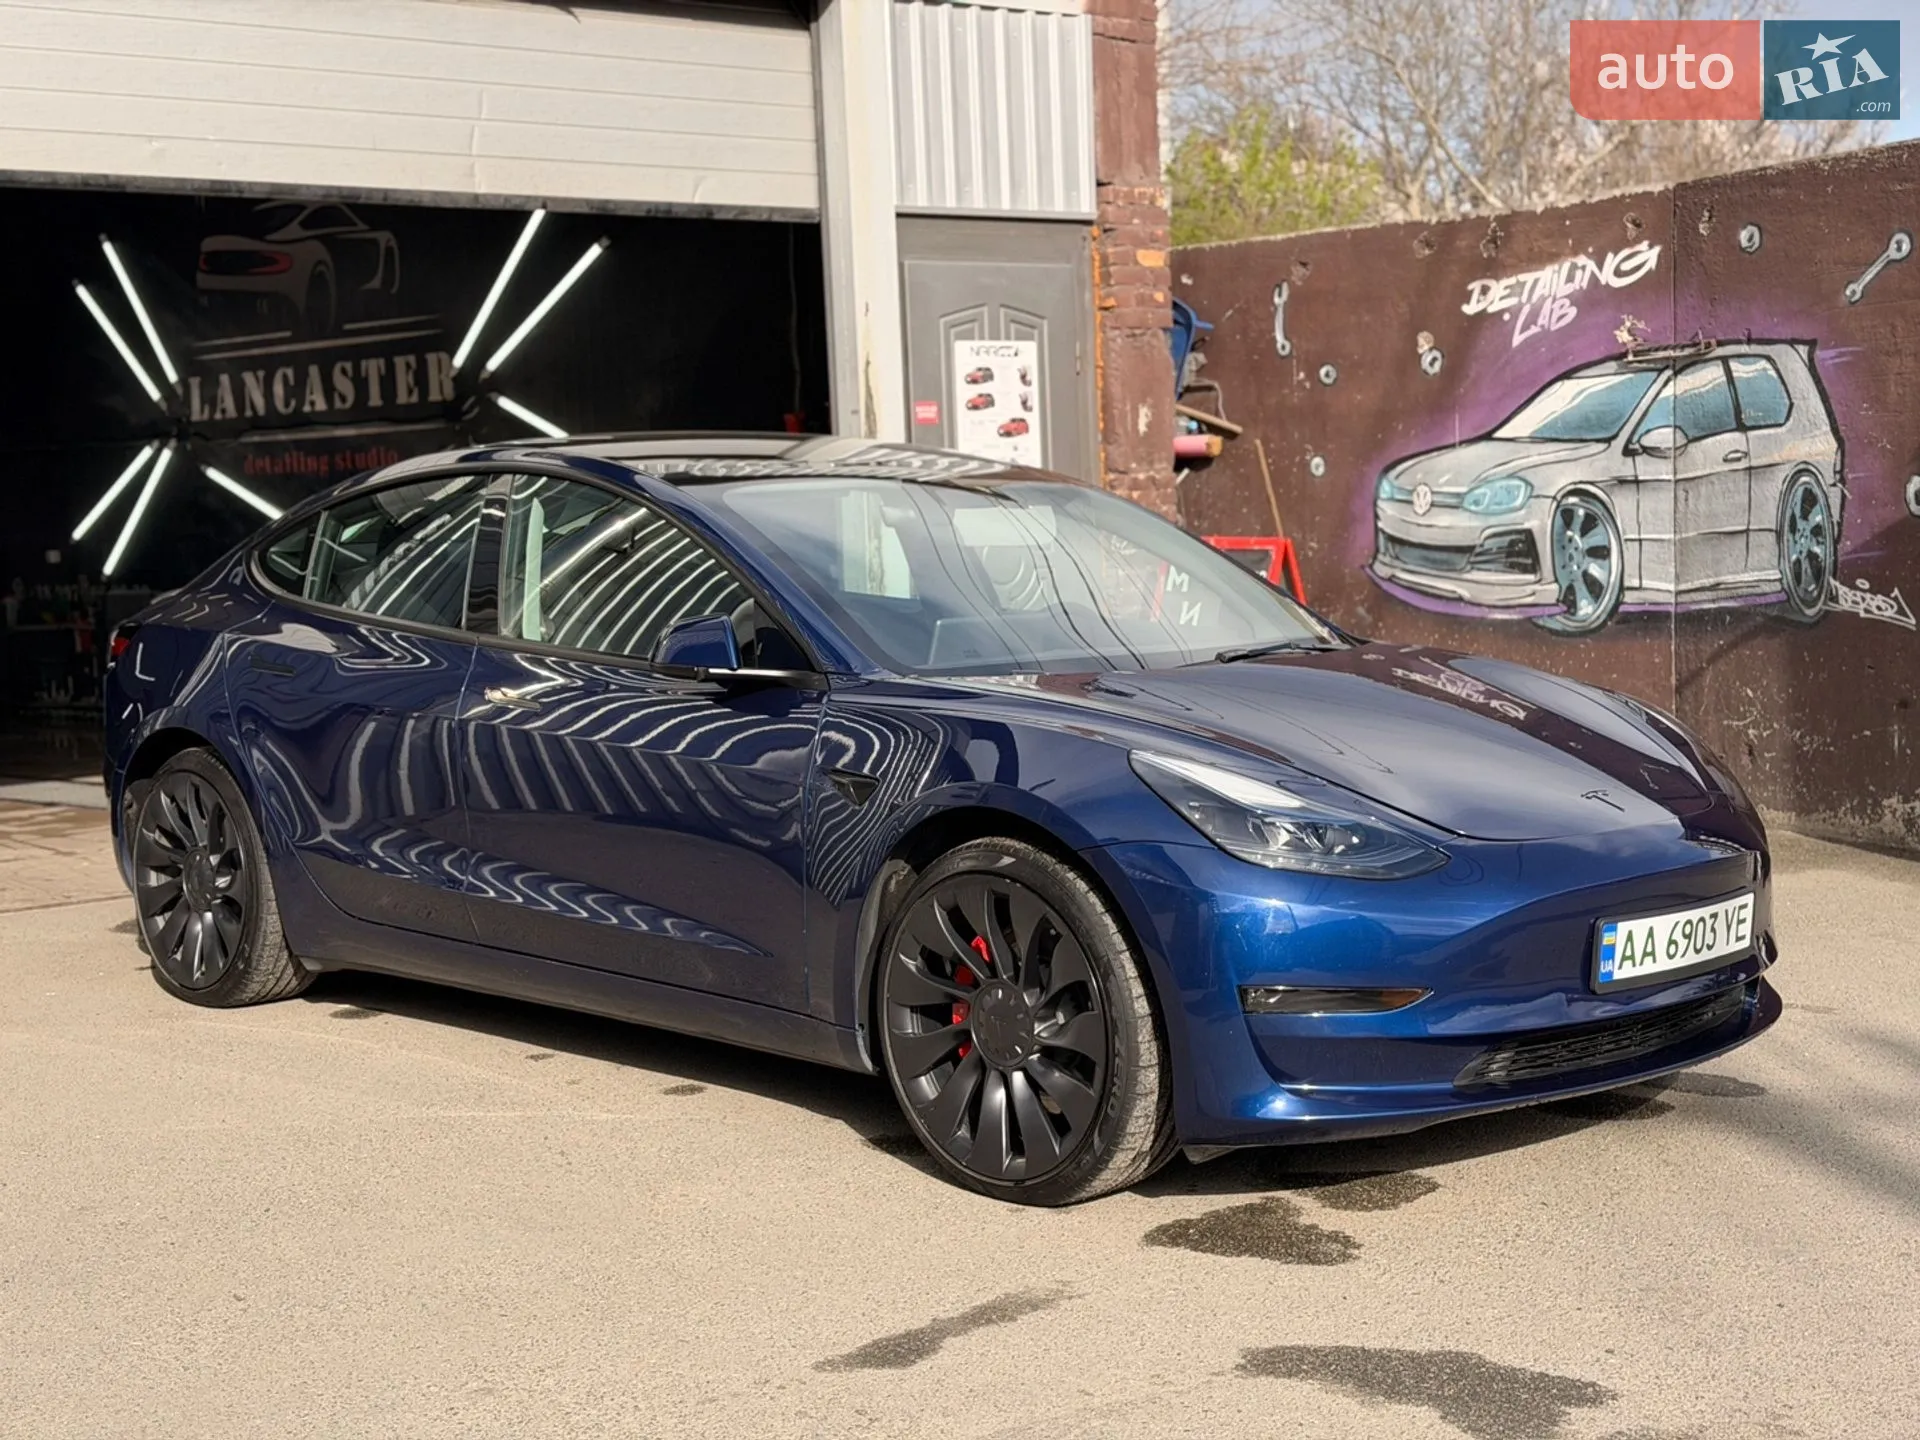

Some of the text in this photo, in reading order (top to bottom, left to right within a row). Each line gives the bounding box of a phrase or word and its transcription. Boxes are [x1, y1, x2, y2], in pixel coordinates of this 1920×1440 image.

[1512, 297, 1578, 349] LAB
[188, 351, 456, 422] LANCASTER
[243, 445, 399, 479] detailing studio
[1617, 902, 1749, 971] AA 6903 YE
[1600, 960, 1613, 974] UA
